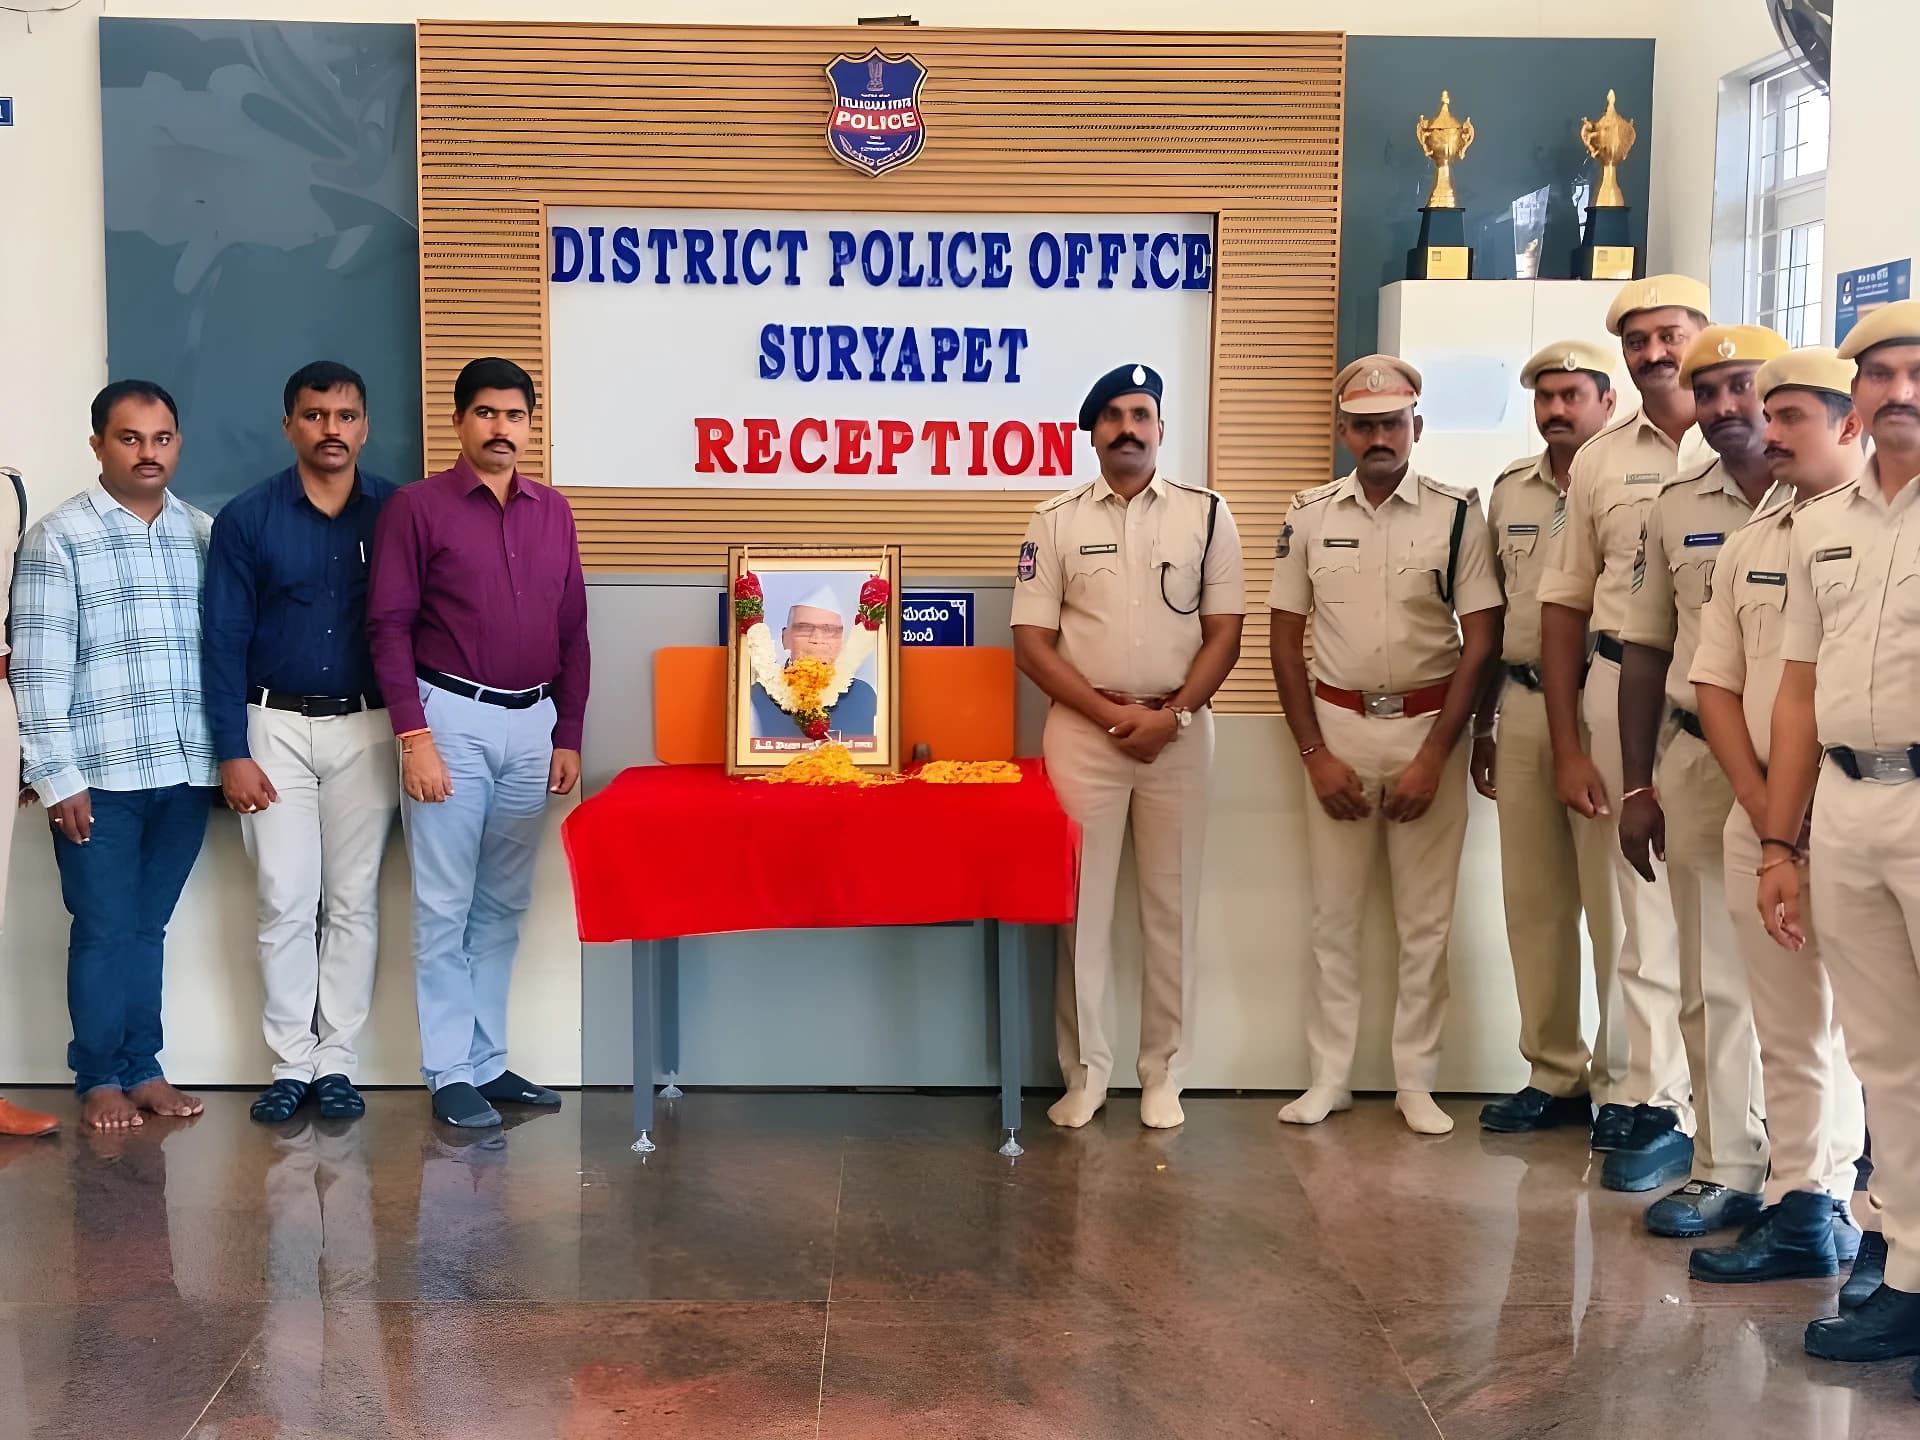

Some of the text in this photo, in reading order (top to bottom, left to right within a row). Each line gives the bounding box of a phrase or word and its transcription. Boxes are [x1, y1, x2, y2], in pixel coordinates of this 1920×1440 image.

[836, 111, 916, 130] POLICE
[551, 226, 1212, 290] DISTRICT POLICE OFFICE
[759, 323, 1029, 384] SURYAPET
[694, 417, 1078, 477] RECEPTION
